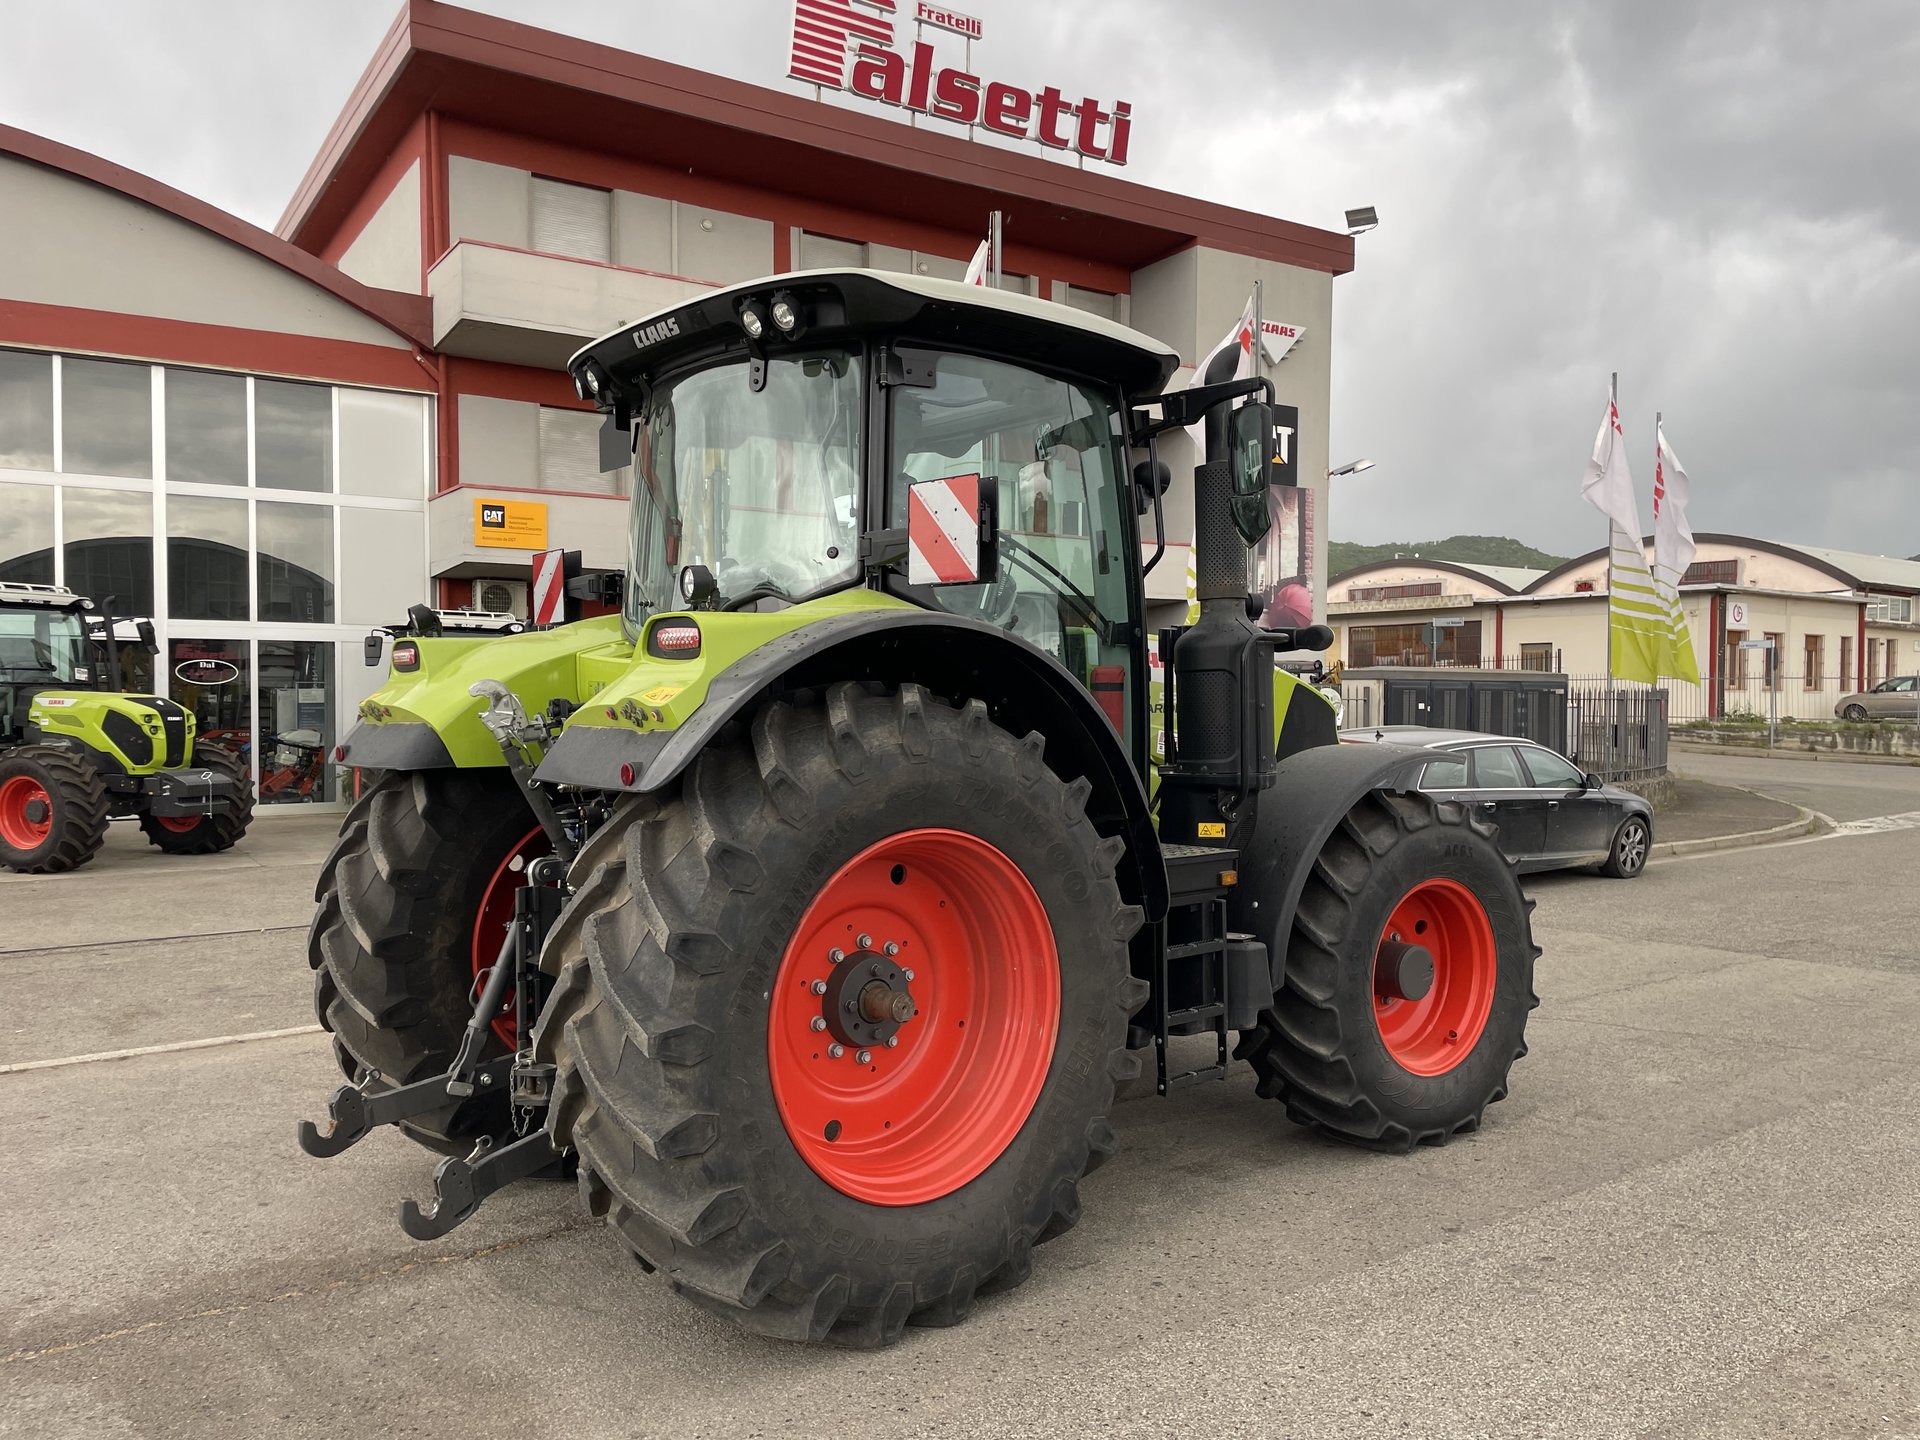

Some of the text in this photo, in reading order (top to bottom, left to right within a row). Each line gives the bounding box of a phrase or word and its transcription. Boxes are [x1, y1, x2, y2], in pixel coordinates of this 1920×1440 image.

[917, 2, 981, 36] Fratelli
[632, 317, 680, 349] CLAAS
[484, 510, 503, 523] CAT
[199, 661, 215, 669] Dal
